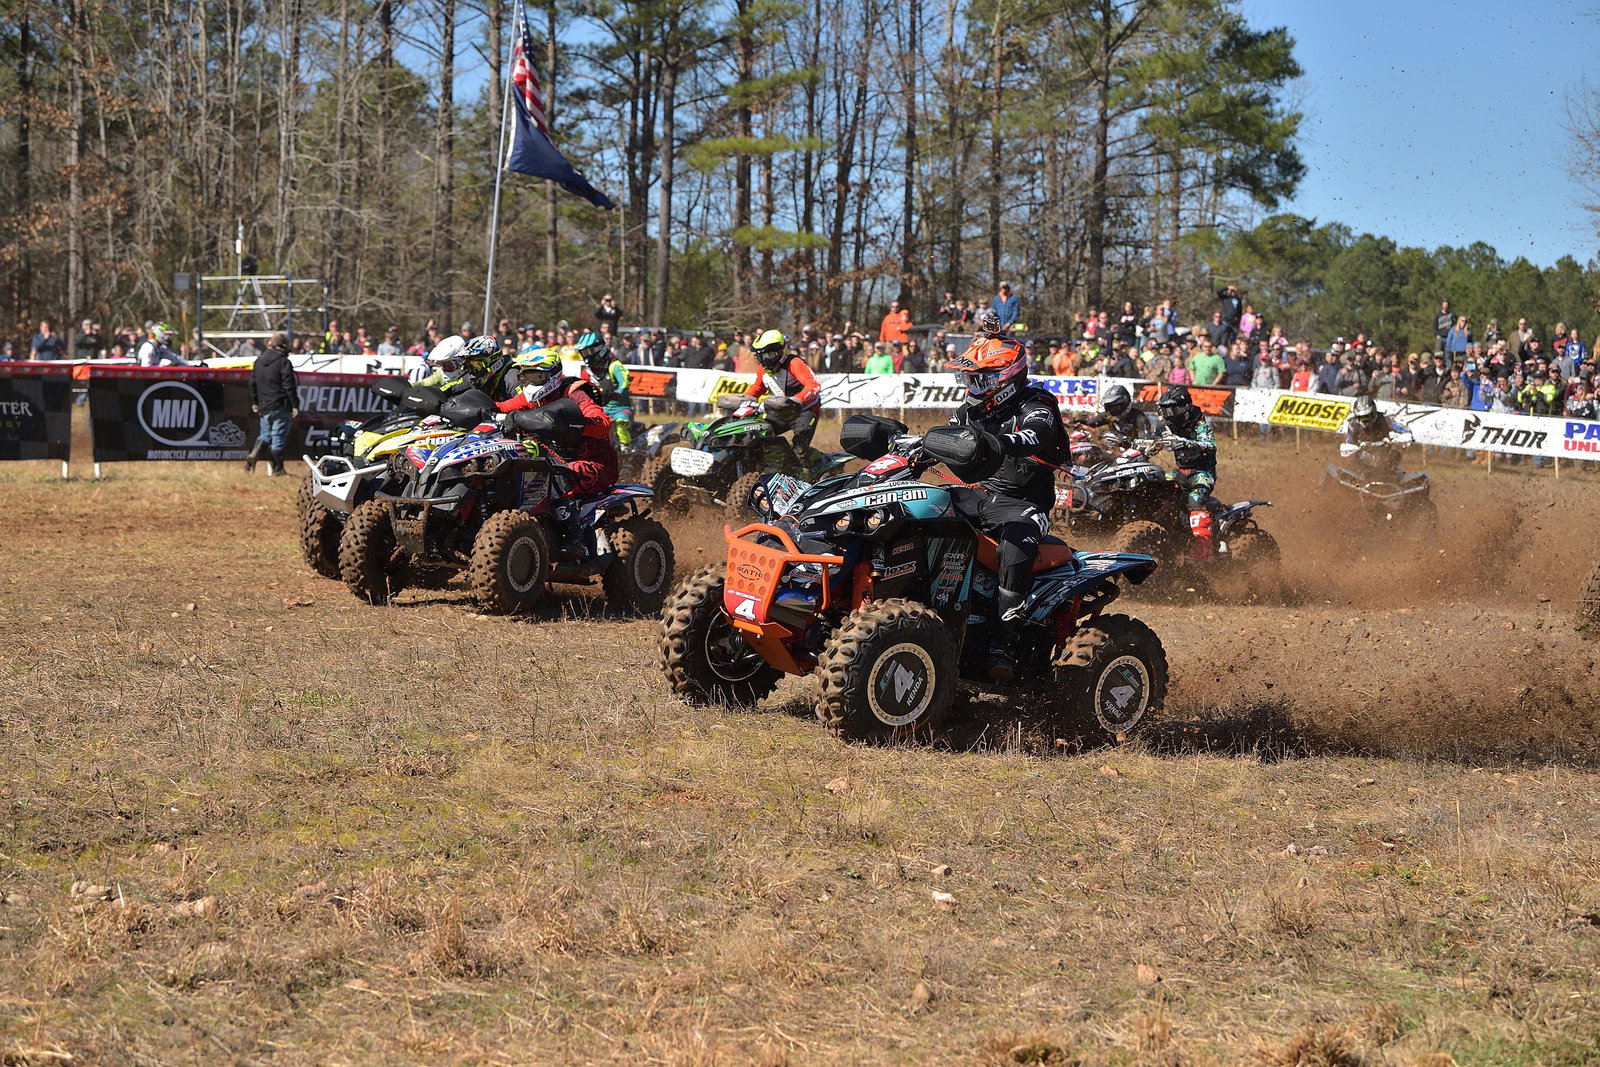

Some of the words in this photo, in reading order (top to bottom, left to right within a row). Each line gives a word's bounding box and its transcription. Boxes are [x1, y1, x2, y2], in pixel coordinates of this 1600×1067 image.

[152, 400, 198, 428] MMI
[1276, 399, 1346, 421] MOOSE
[1480, 426, 1548, 449] THOR
[865, 488, 927, 506] can-am
[734, 599, 756, 621] 4
[894, 663, 914, 703] 4
[906, 677, 923, 706] KENDA
[1110, 685, 1136, 708] 4
